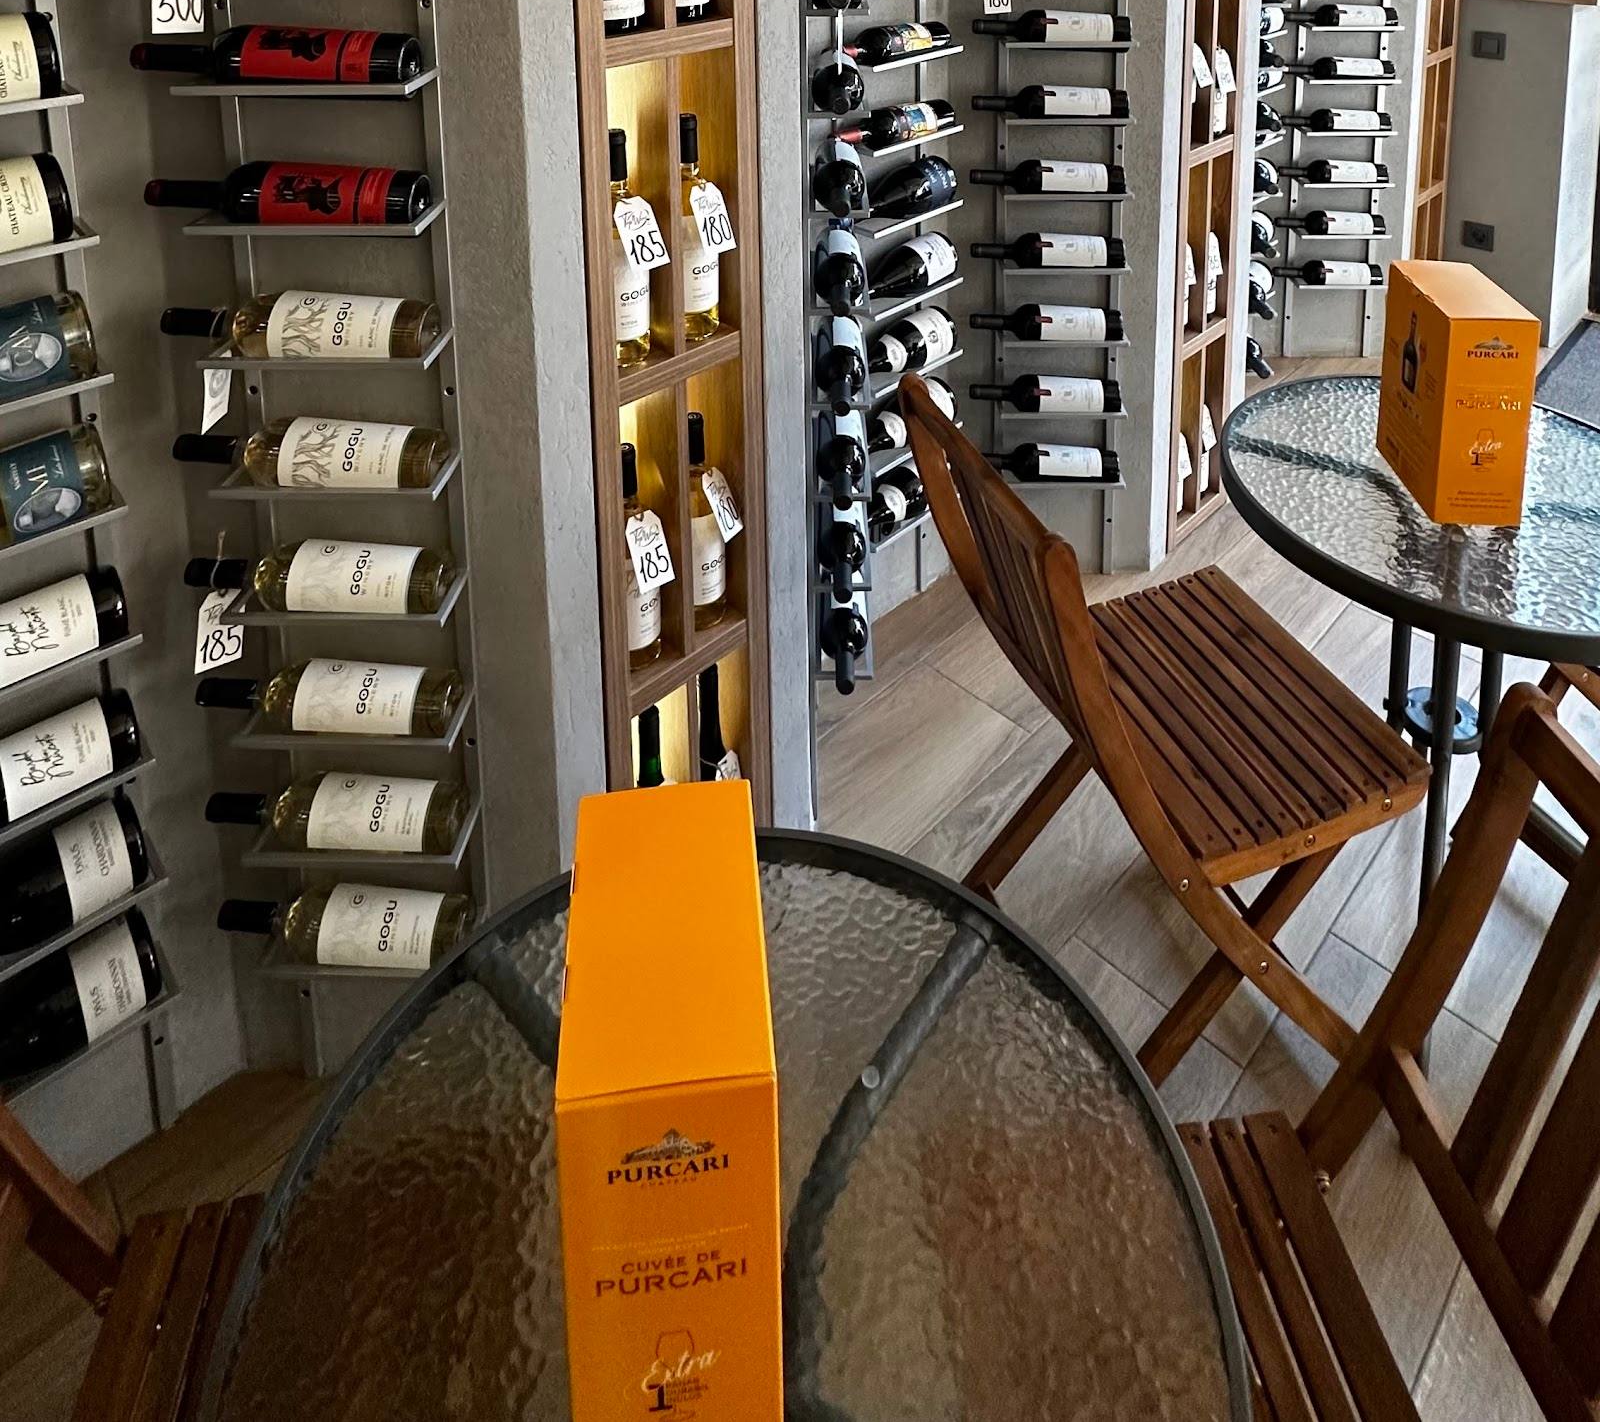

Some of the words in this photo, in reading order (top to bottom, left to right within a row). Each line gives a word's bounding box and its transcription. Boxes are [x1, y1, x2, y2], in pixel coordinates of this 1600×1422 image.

[7, 192, 20, 235] CHATEAU
[702, 214, 732, 246] 180
[630, 230, 665, 265] 185
[332, 302, 352, 346] GOGU
[1467, 350, 1519, 360] PURCARI
[342, 428, 363, 472] GOGU
[715, 496, 739, 533] 180
[350, 550, 371, 595] GOGU
[639, 544, 669, 583] 185
[200, 624, 242, 665] 185
[356, 668, 377, 714] GOGU
[369, 784, 390, 832] GOGU
[378, 900, 398, 952] GOGU
[607, 1153, 730, 1185] PURCARI
[595, 1257, 748, 1298] PURCARI
[621, 1256, 687, 1275] CUVÉE
[696, 1250, 721, 1264] DE
[641, 1349, 722, 1394] Extra
[647, 1383, 673, 1412] 1
